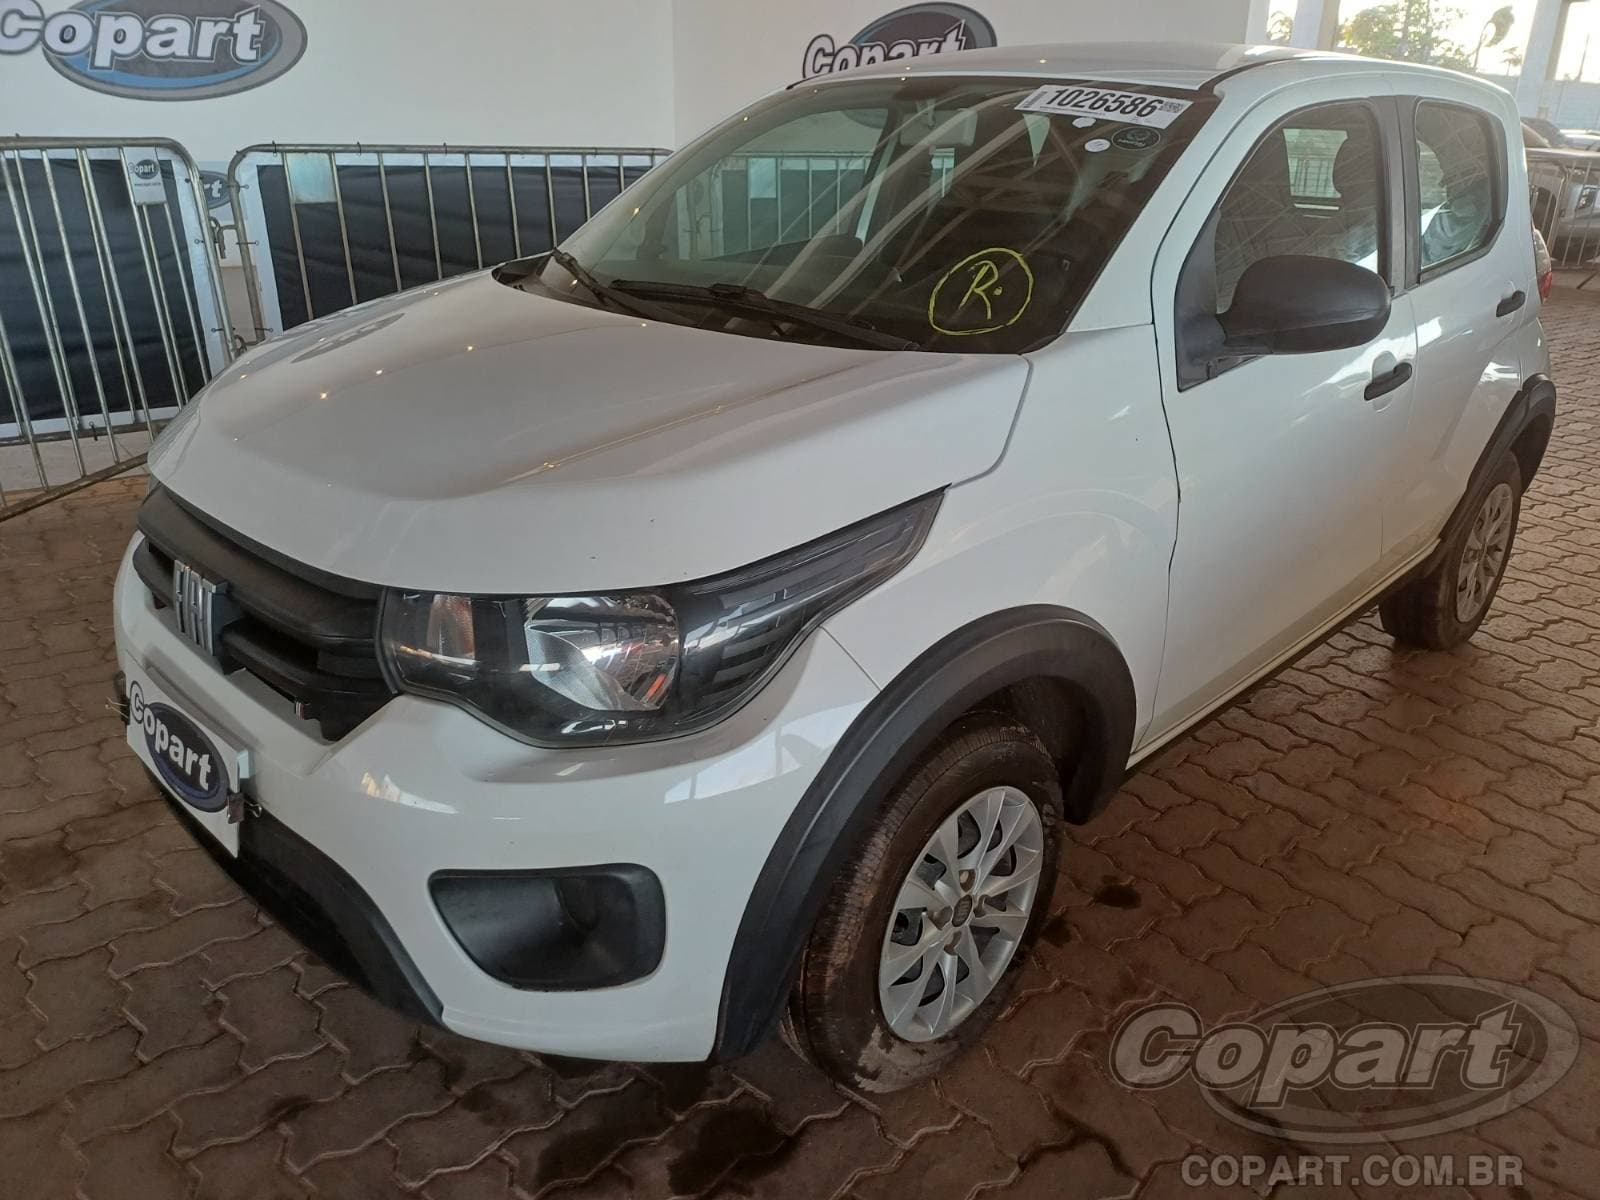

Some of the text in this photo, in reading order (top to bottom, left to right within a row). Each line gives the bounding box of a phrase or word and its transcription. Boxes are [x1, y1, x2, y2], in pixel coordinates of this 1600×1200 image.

[0, 0, 264, 71] Copart
[1046, 88, 1164, 118] 1026586
[129, 680, 213, 792] Copart
